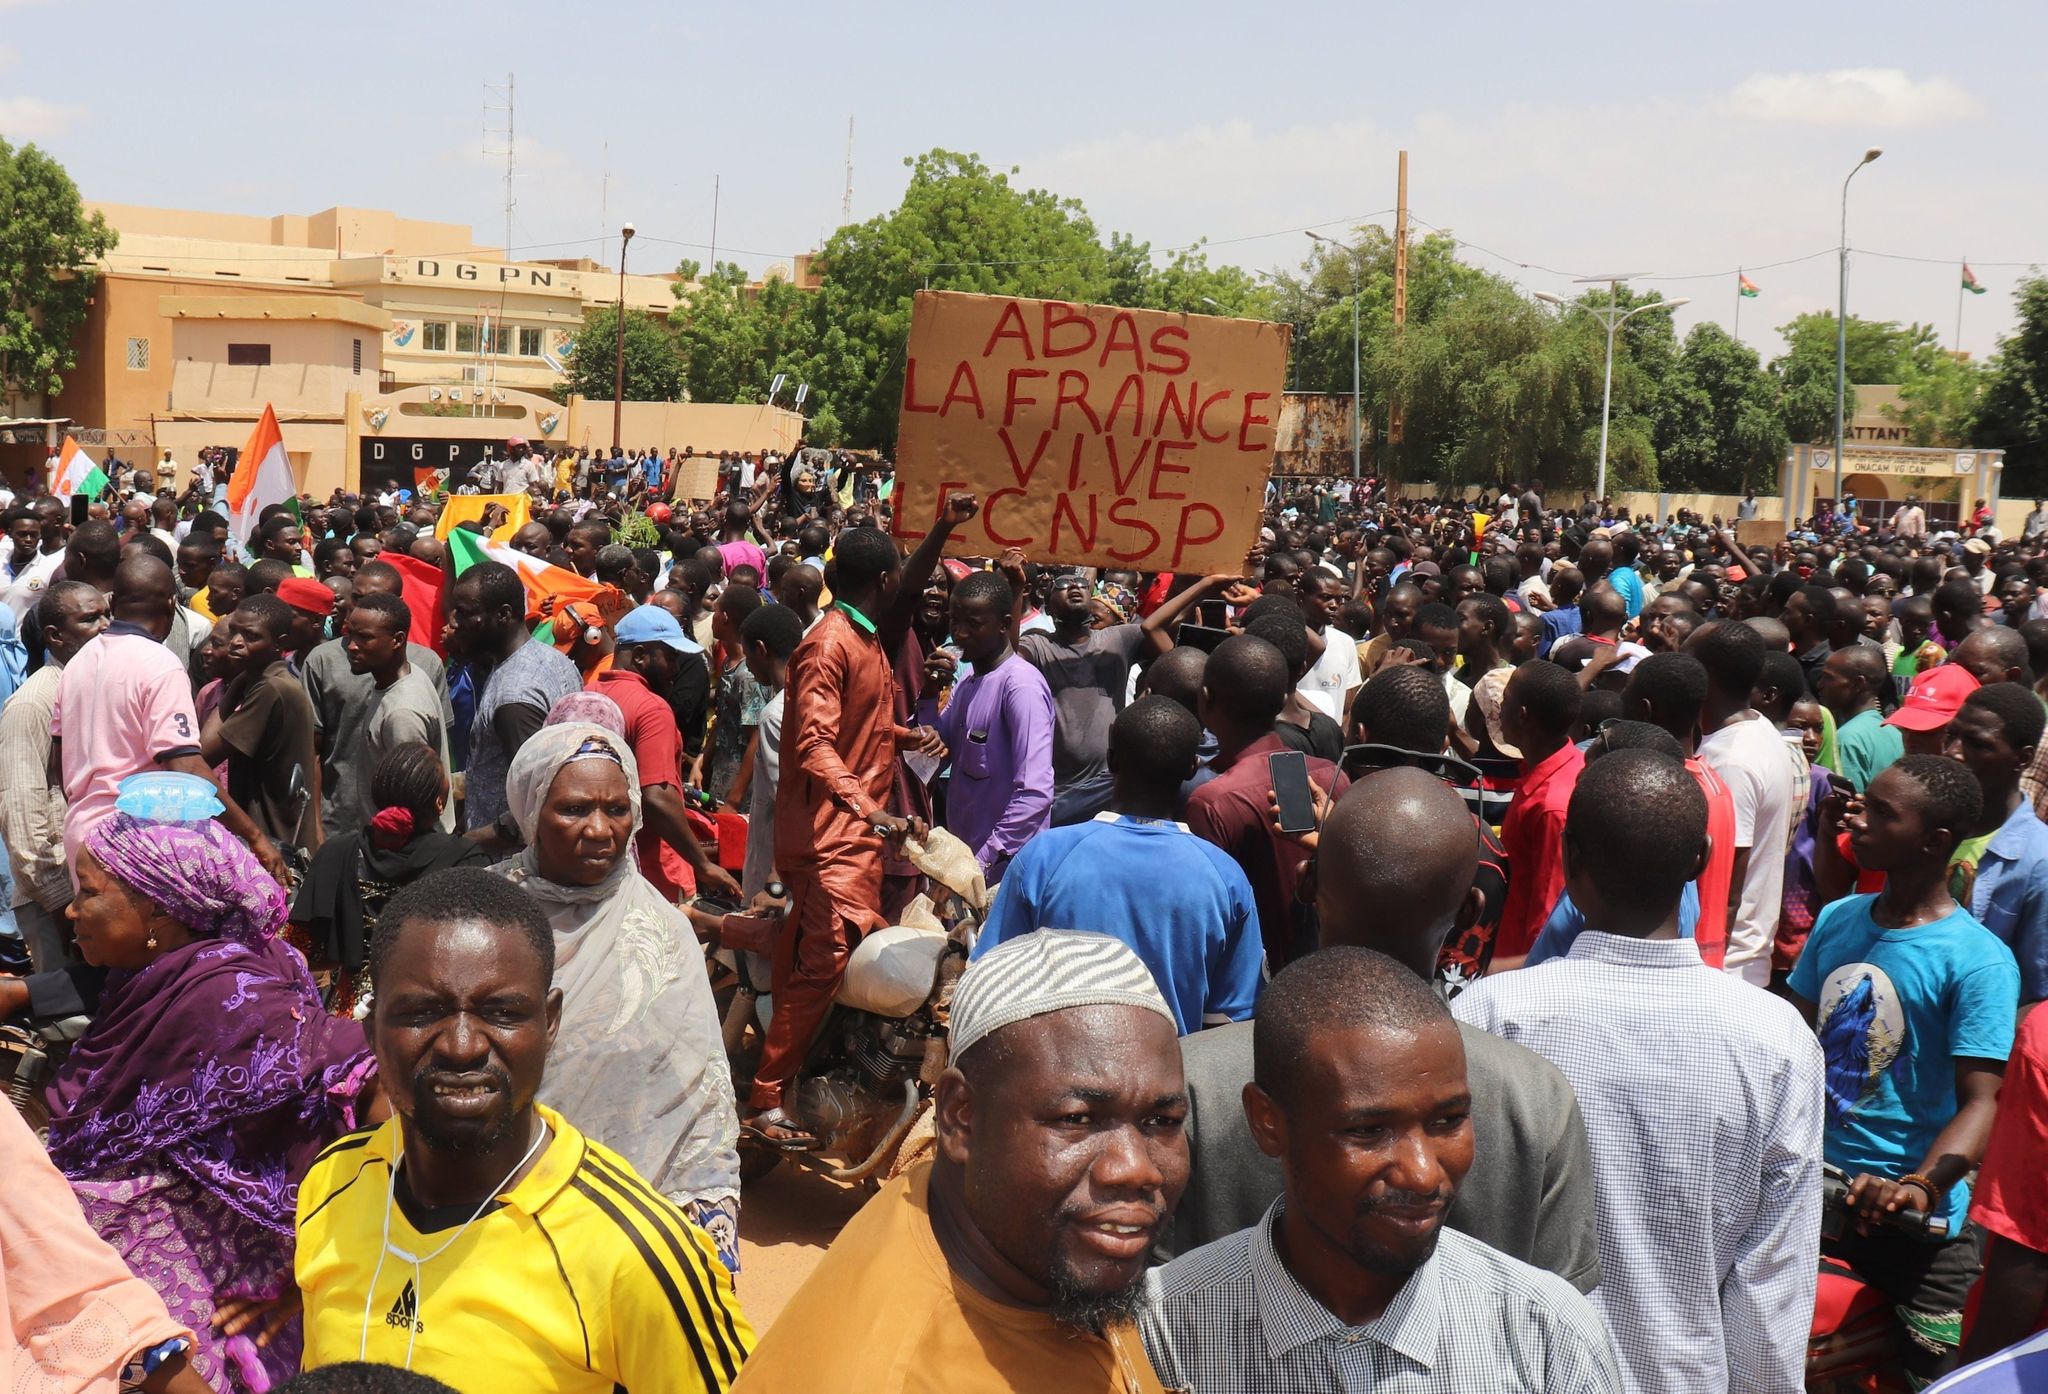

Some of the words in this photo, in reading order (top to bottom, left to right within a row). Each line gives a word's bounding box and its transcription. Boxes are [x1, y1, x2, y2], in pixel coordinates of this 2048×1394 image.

[418, 260, 551, 287] DGPN
[1002, 368, 1272, 451] FRANCE
[997, 427, 1197, 500] VIVE
[1909, 465, 1927, 474] CAN
[174, 712, 191, 738] 3
